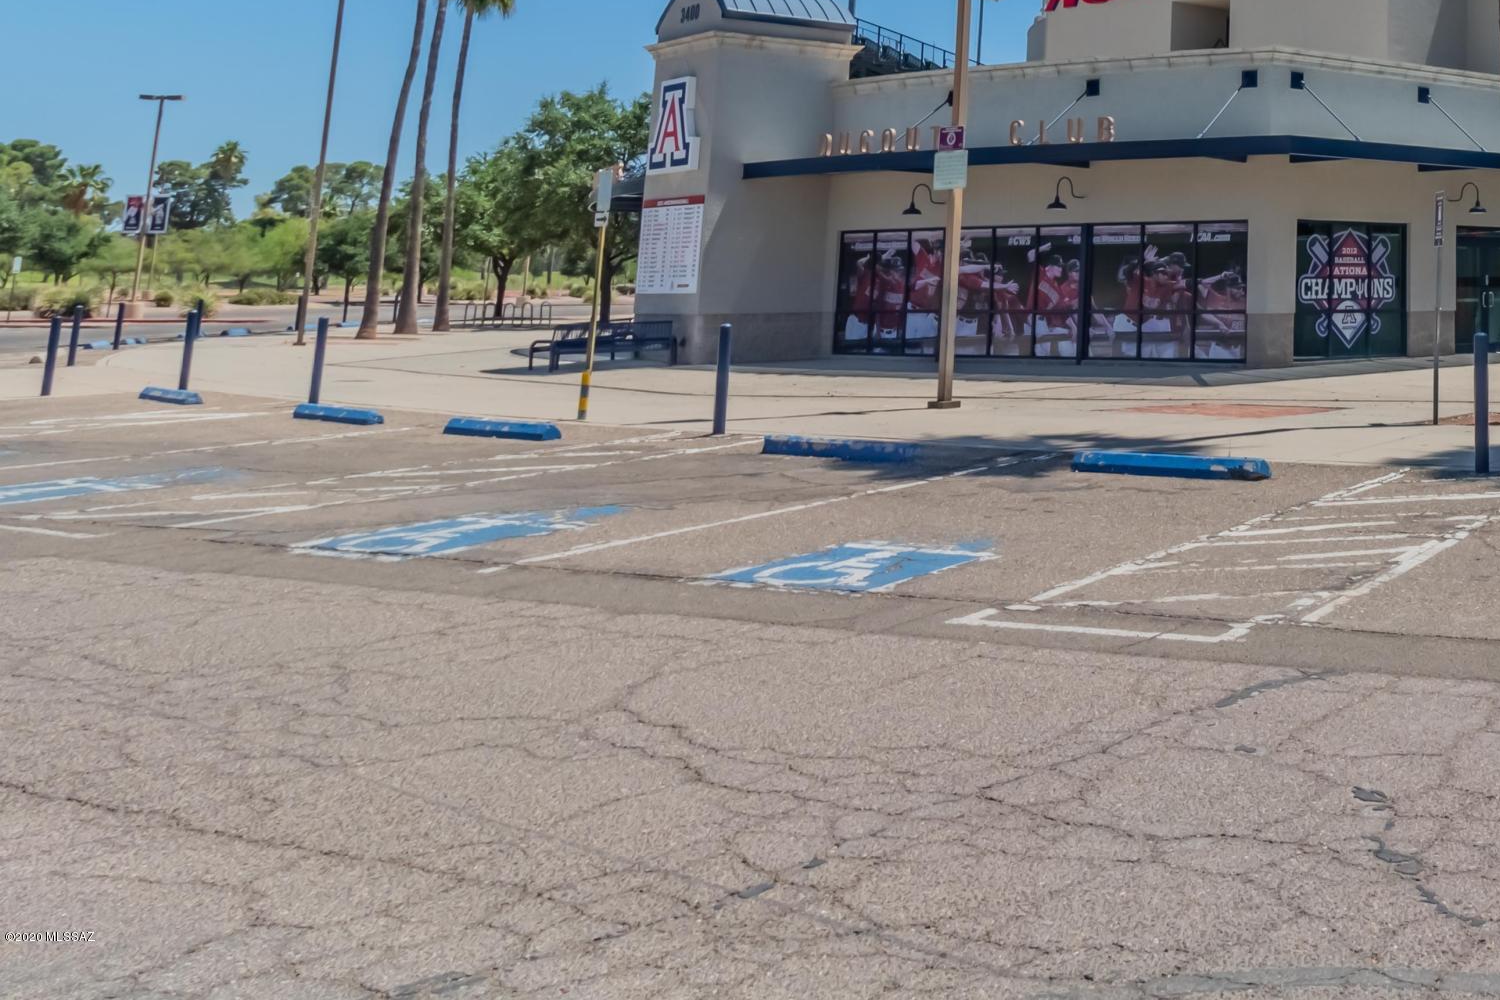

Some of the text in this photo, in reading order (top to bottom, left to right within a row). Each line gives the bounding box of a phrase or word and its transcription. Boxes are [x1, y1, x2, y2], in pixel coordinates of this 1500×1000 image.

[680, 3, 700, 24] 3400
[647, 77, 697, 174] A
[1009, 115, 1116, 147] CLUB
[1327, 266, 1373, 275] ATIONA
